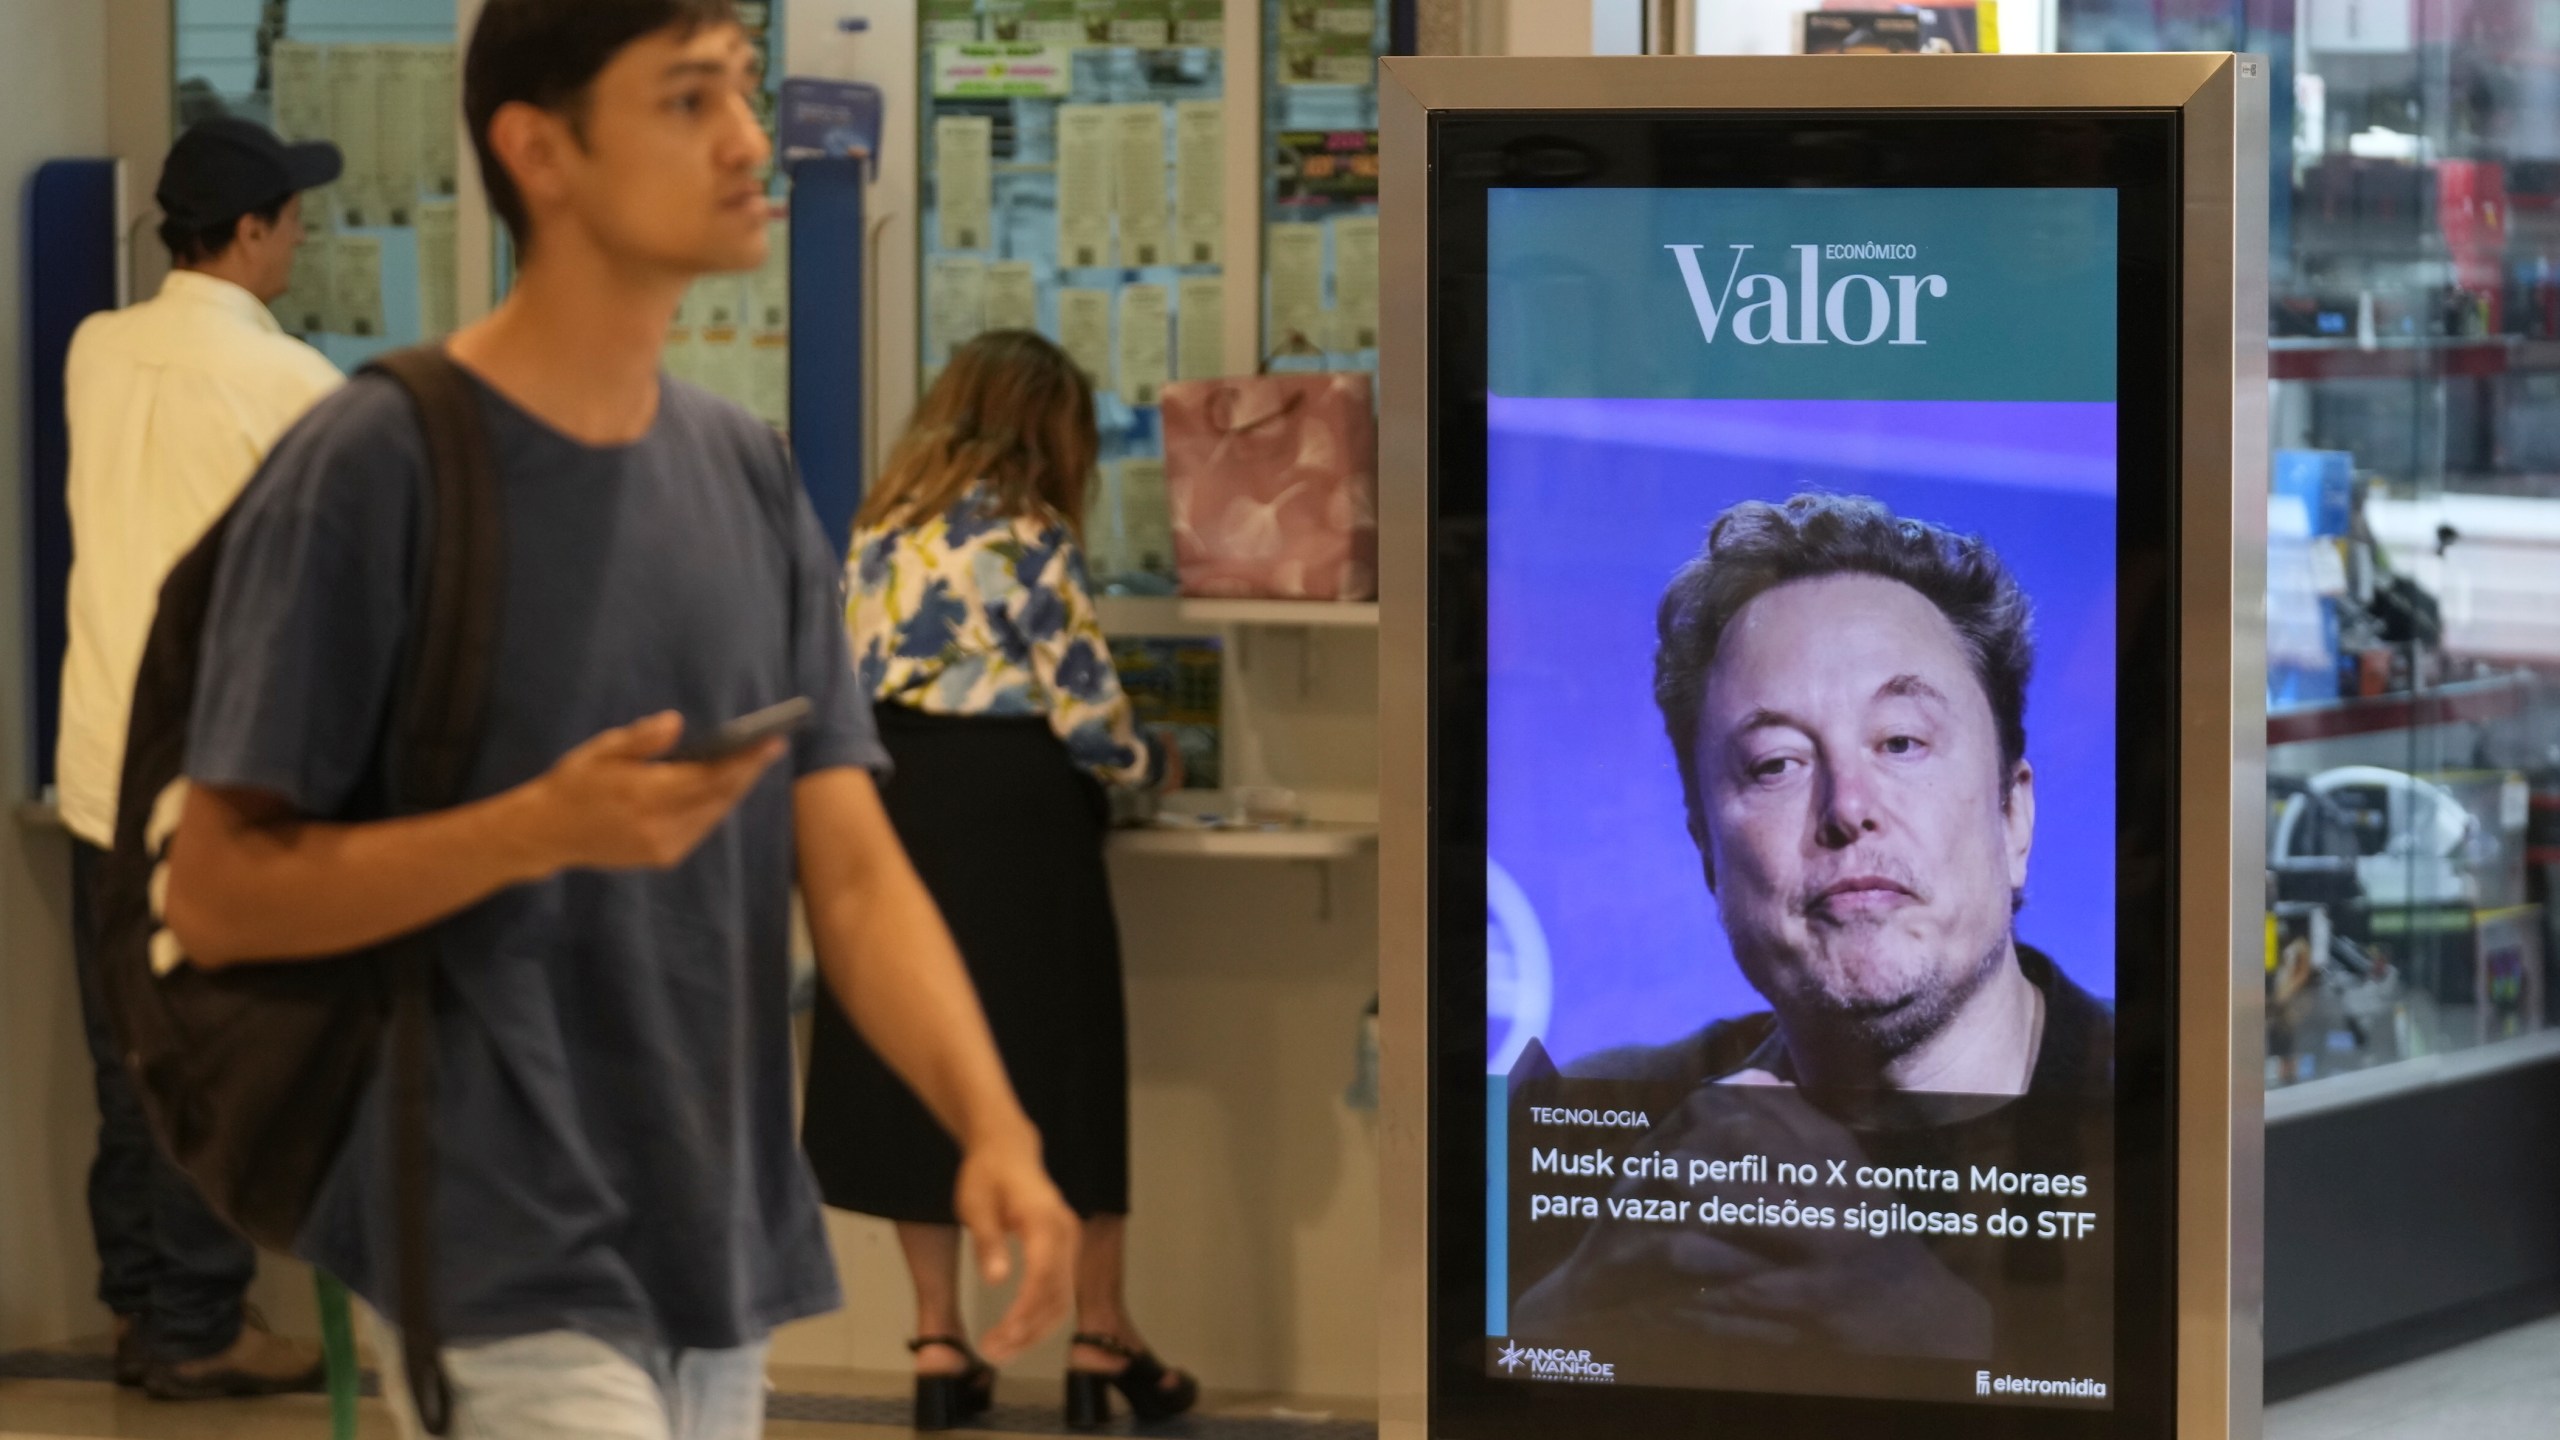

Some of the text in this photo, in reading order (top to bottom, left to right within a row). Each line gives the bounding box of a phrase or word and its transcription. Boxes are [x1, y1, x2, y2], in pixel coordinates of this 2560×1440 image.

[1826, 241, 1917, 260] ECONÔMICO
[1664, 244, 1948, 345] Valor
[1530, 1106, 1650, 1128] TECNOLOGIA
[1532, 1147, 2088, 1196] Musk cria perfil no X contra Moraes
[1532, 1195, 2096, 1239] para vazar decisões sigilosas do STF
[1524, 1347, 1591, 1362] ANCAR
[1531, 1360, 1614, 1376] IVANHOE
[1993, 1374, 2107, 1397] eletromidia
